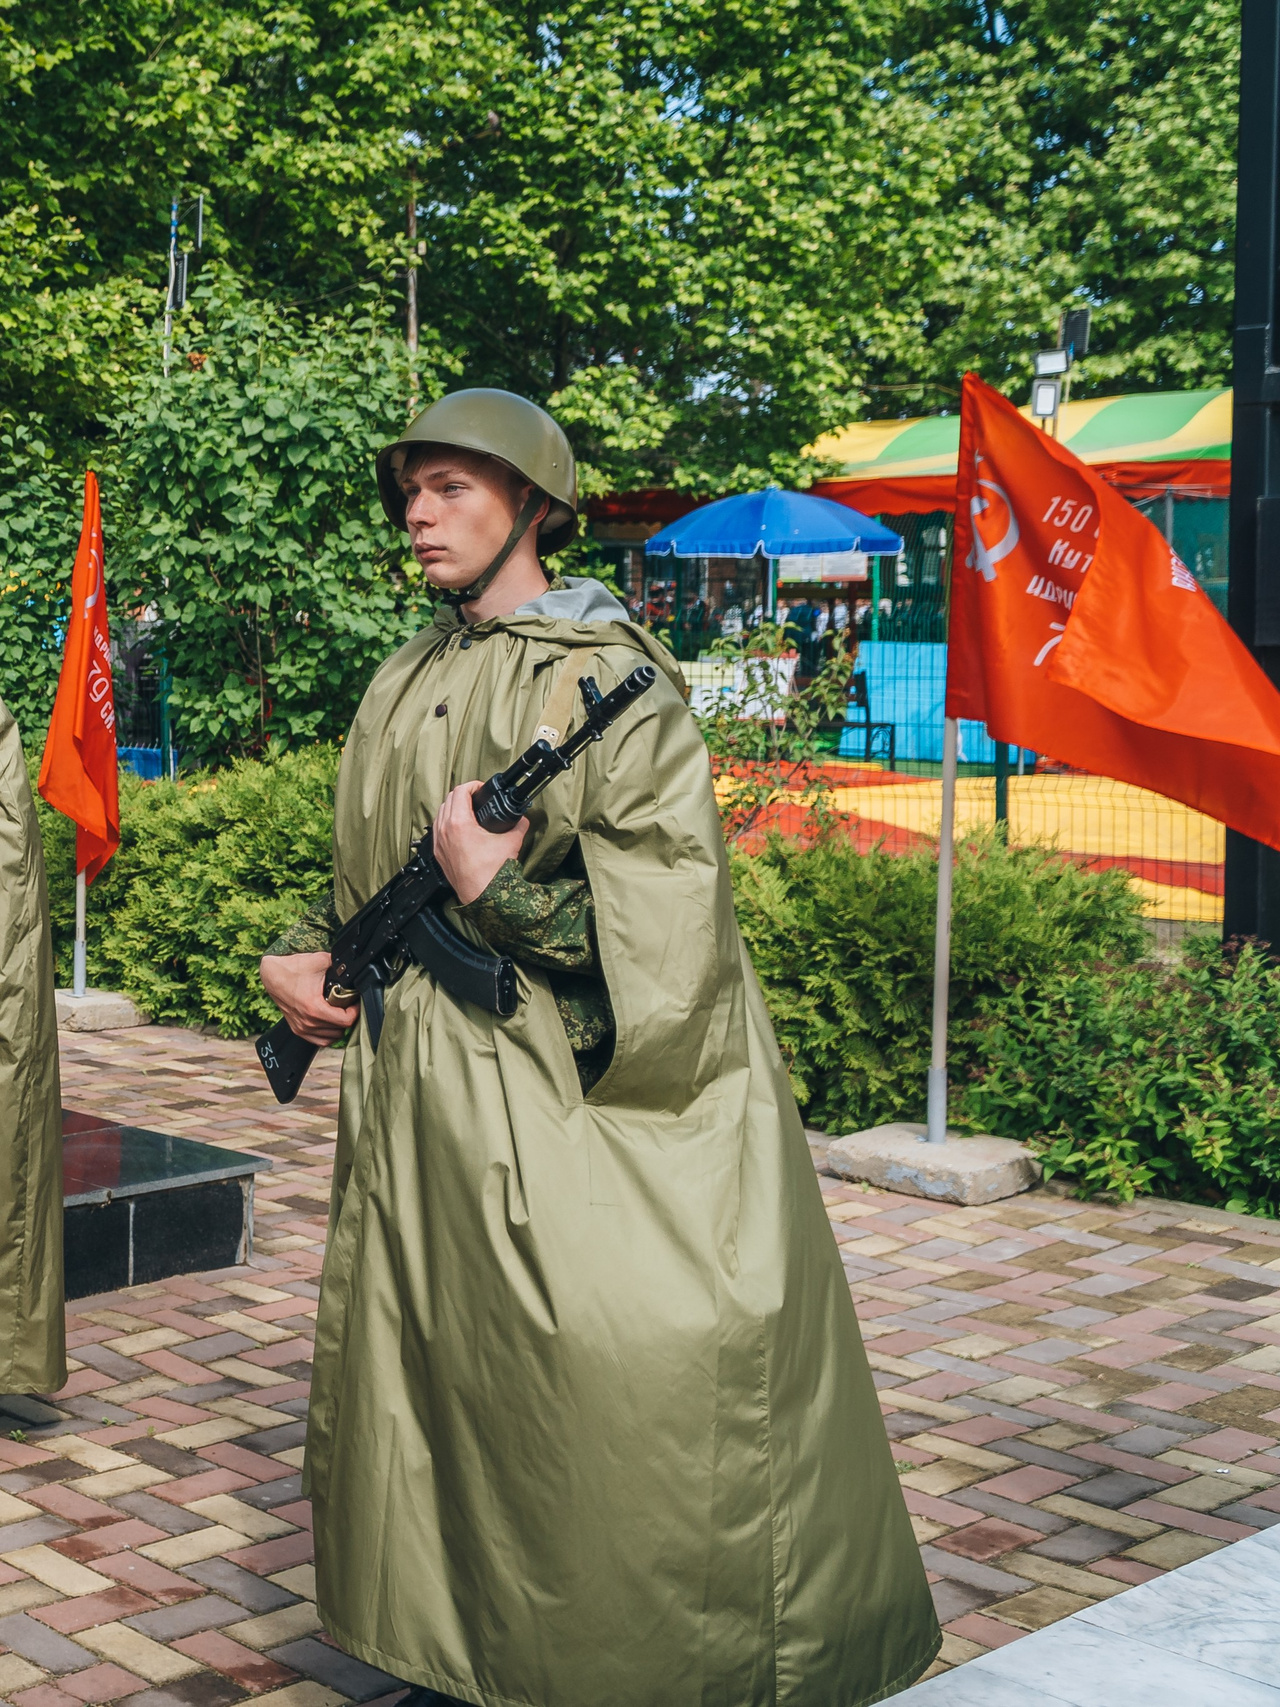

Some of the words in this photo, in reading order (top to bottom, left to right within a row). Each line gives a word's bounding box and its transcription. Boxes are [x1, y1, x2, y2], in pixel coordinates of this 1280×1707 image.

[1042, 495, 1093, 533] 150
[87, 659, 109, 703] 79
[260, 1041, 280, 1069] 35
